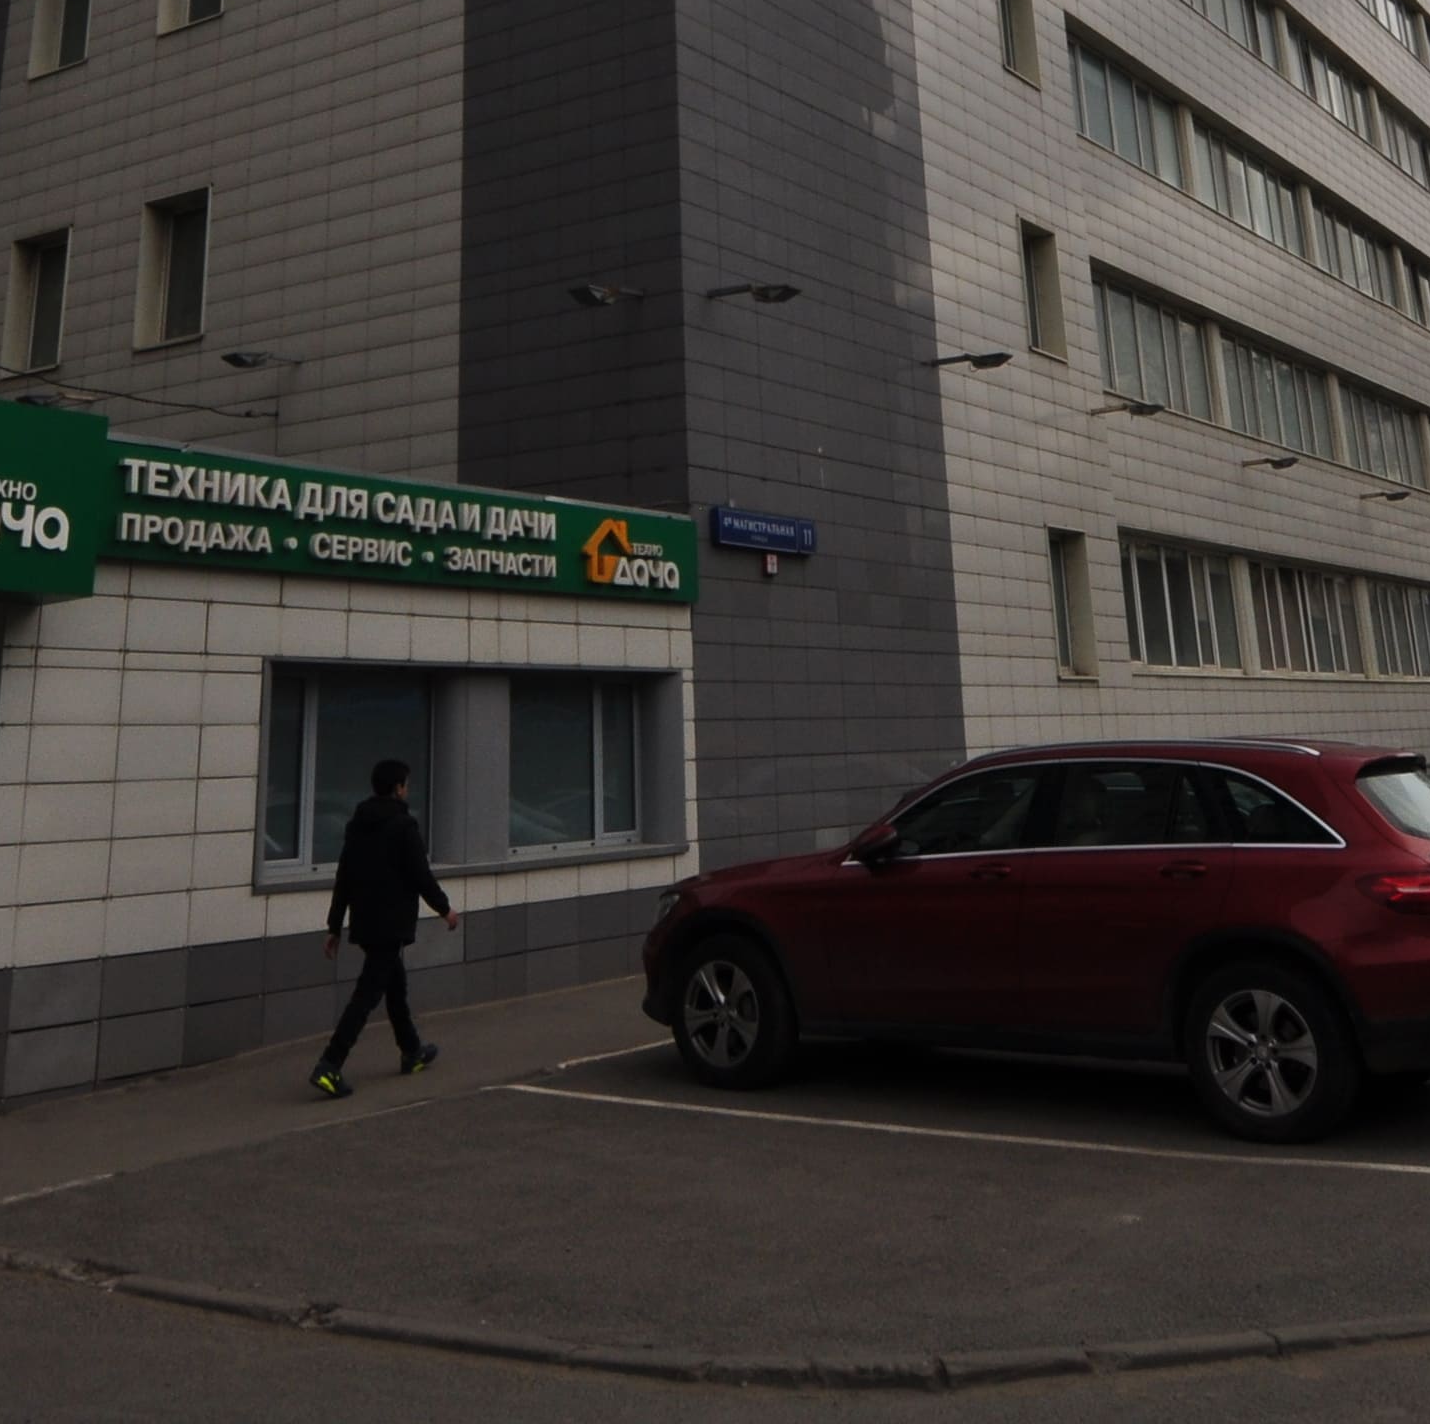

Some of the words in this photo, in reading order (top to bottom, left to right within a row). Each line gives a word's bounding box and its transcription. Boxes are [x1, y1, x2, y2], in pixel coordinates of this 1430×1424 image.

[121, 458, 292, 512] ТЕХНИКА
[294, 481, 368, 522] ДЛЯ
[373, 491, 457, 535] САДА
[458, 502, 481, 533] И
[482, 506, 557, 542] ДАЧИ
[118, 512, 273, 554] ПРОДАЖА
[309, 532, 412, 567] СЕРВИС
[444, 546, 558, 578] ЗАПЧАСТИ
[803, 528, 812, 545] 11
